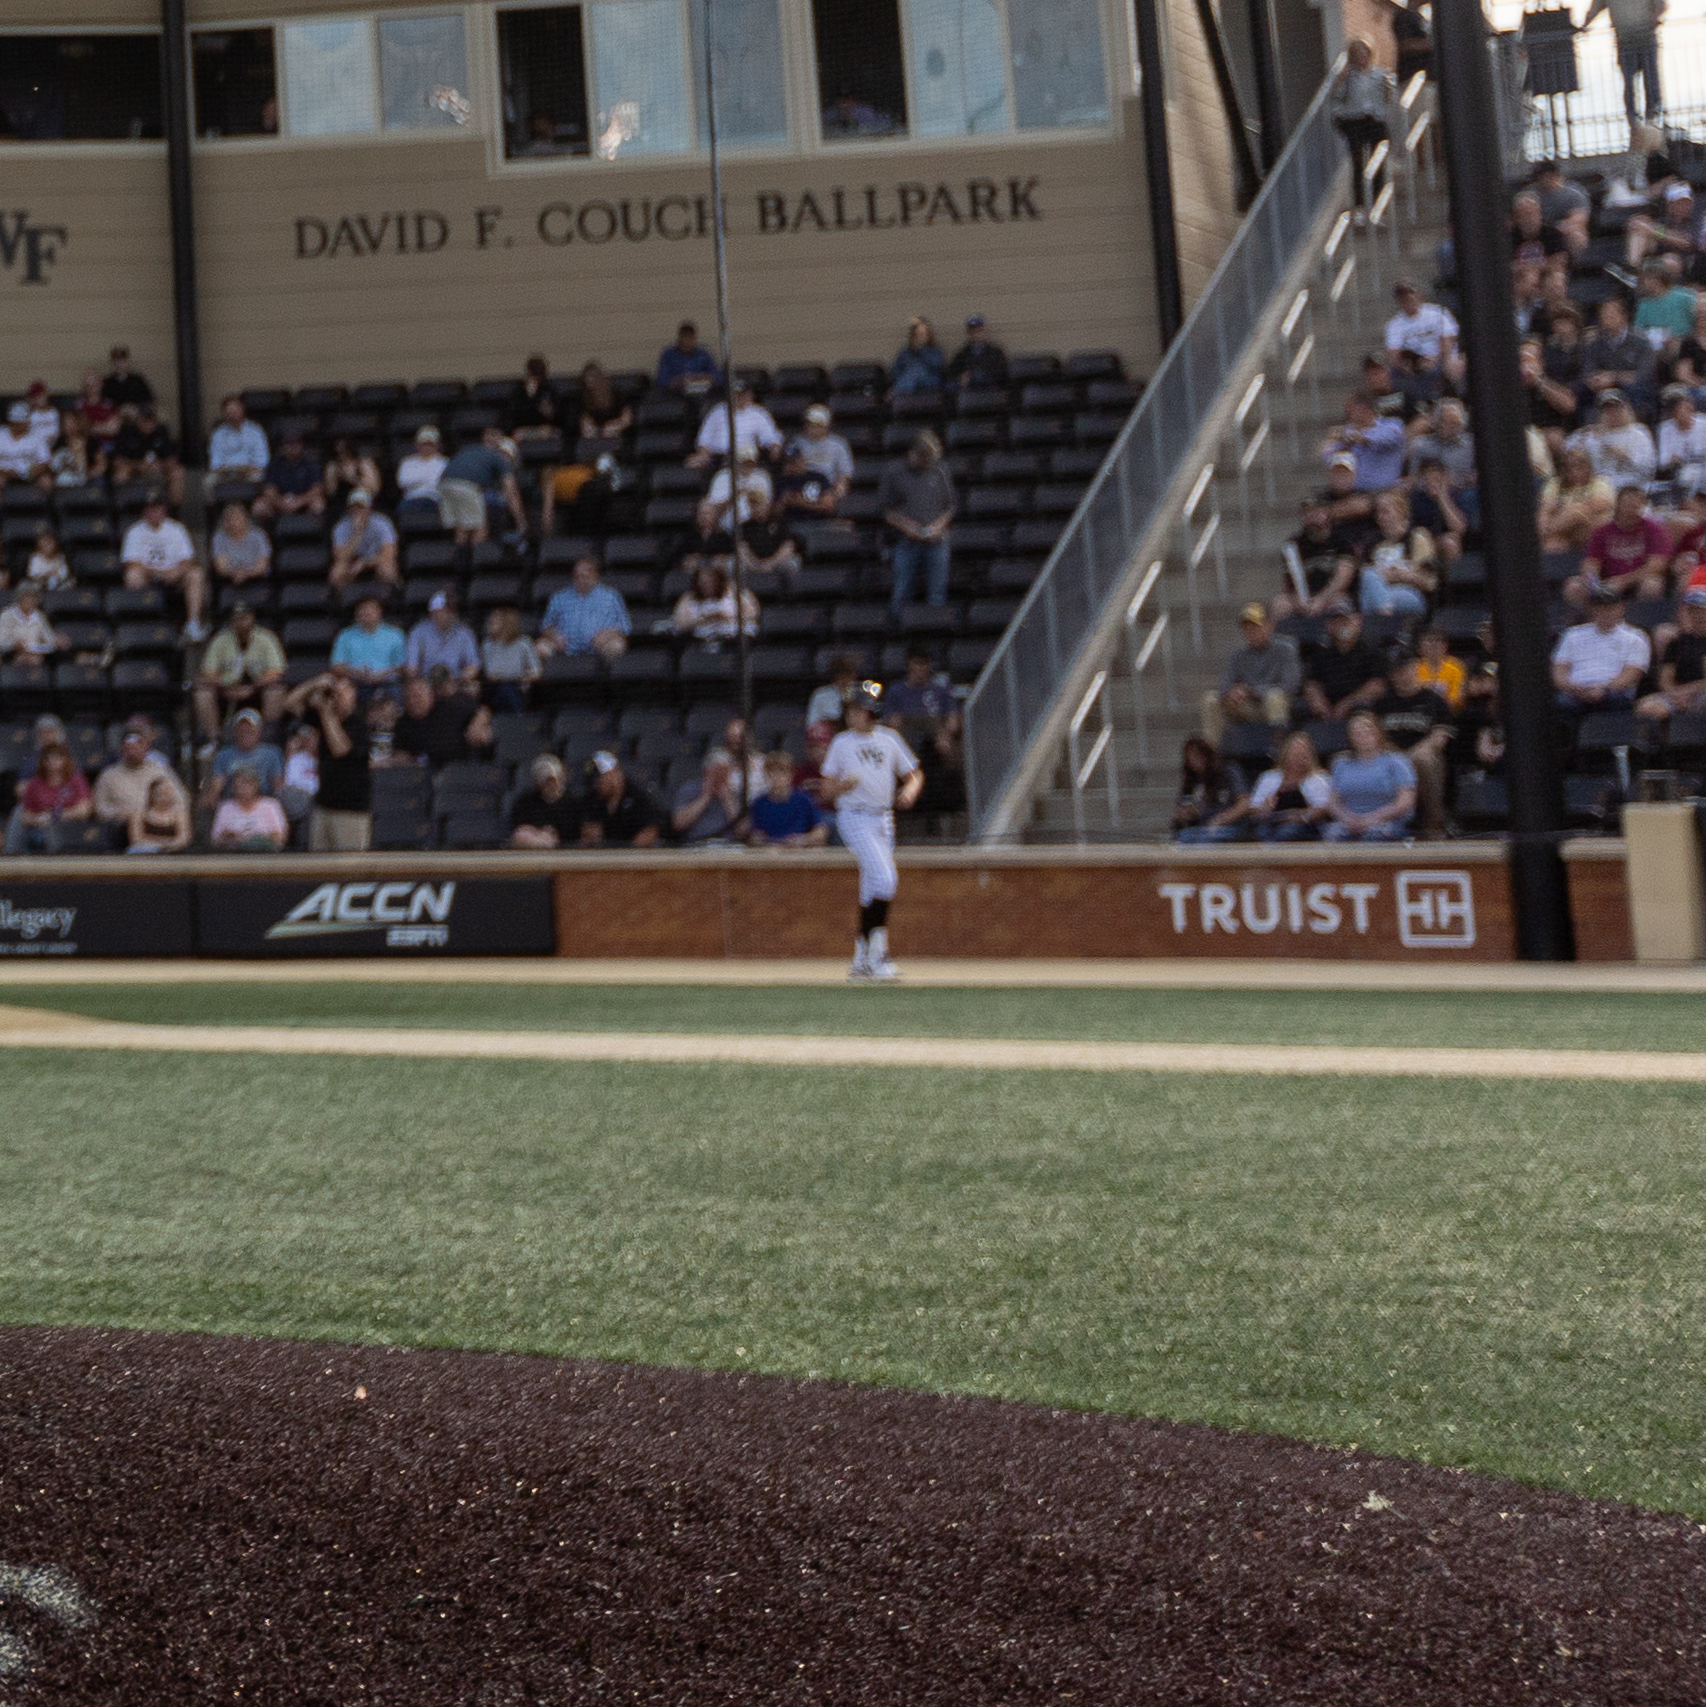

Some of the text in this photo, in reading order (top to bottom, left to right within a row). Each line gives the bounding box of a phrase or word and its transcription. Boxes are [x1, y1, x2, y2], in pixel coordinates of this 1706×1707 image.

[294, 176, 1044, 260] DAVID F. COUCH BALLPARK
[286, 881, 457, 922] ACCN
[1157, 882, 1381, 935] TRUIST
